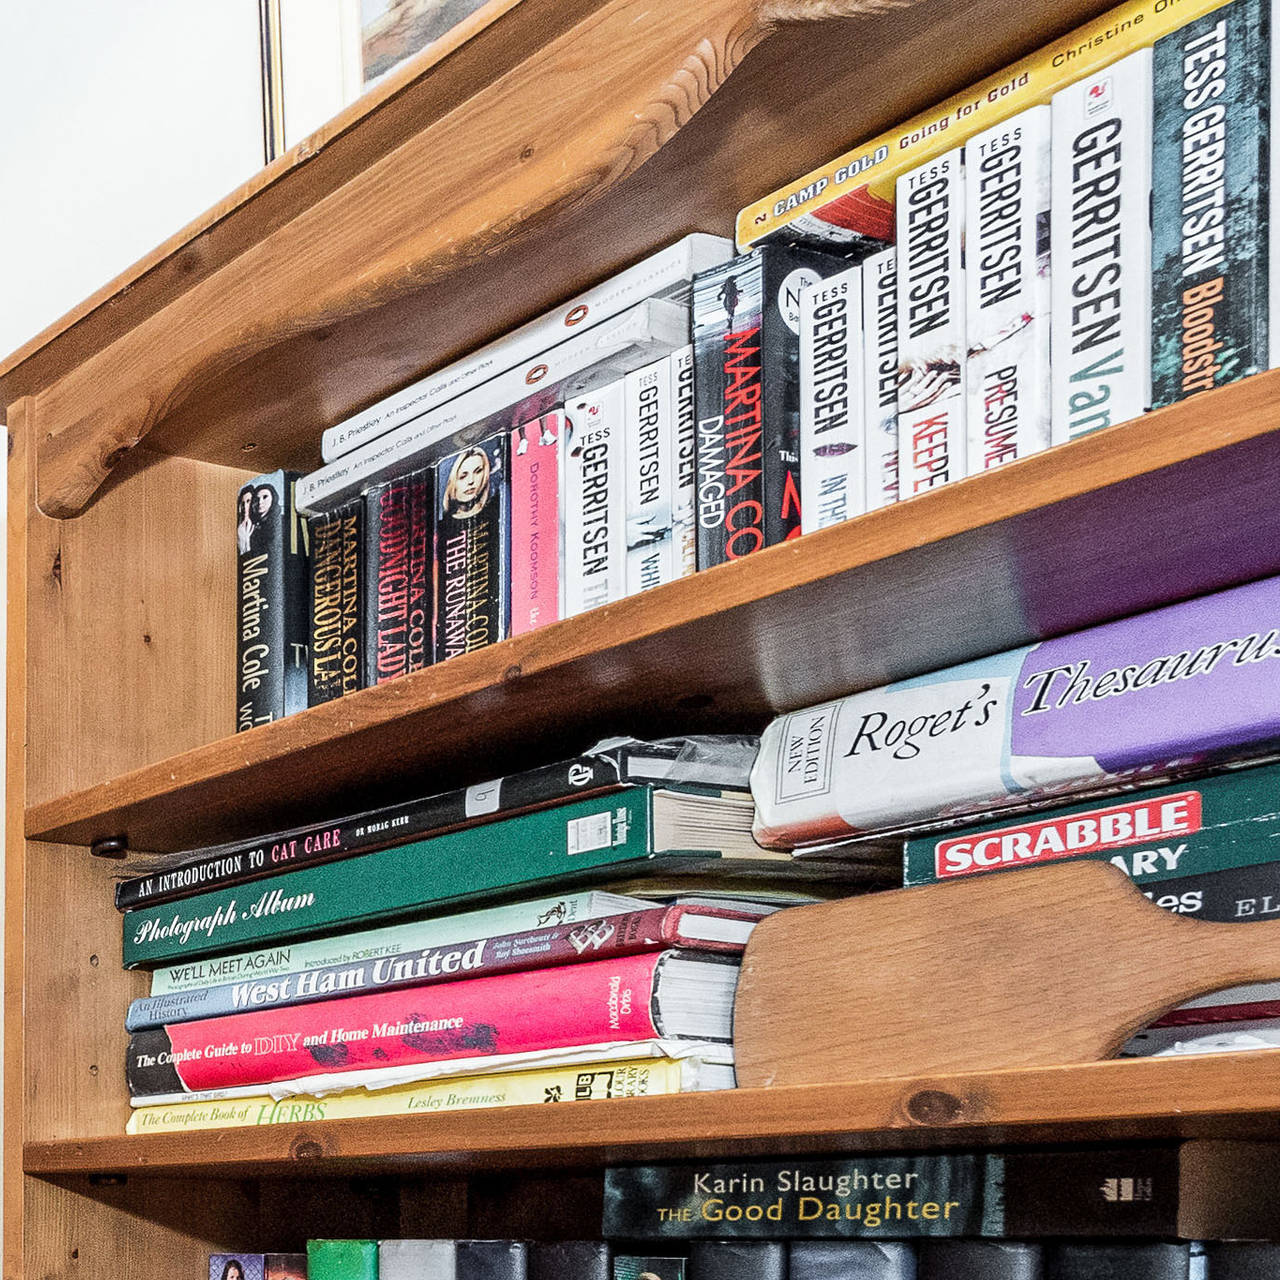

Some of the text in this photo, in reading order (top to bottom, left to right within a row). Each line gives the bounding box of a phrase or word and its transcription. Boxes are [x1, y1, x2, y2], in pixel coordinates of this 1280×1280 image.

[1184, 20, 1227, 110] TESS
[772, 179, 828, 218] CAMP
[834, 145, 889, 185] GOLD
[899, 117, 950, 150] Going
[956, 101, 982, 120] for
[987, 72, 1030, 104] Gold
[1051, 13, 1145, 69] Christine
[978, 127, 1022, 157] TESS
[908, 160, 950, 190] TESS
[1183, 104, 1226, 278] GERRITSEN
[1071, 117, 1123, 355] GERRITSEN
[812, 283, 848, 304] TESS
[580, 427, 611, 445] TESS
[723, 326, 761, 496] MARTINA
[638, 386, 661, 506] GERRITSEN
[698, 414, 725, 529] DAMAGED
[530, 463, 539, 529] DOROTHY
[530, 532, 539, 600] KOOMSON
[241, 553, 270, 692] Martina Cole
[843, 630, 1280, 760] Roget's Thesauru
[786, 734, 804, 774] NEW
[803, 715, 827, 787] EDITION
[945, 800, 1188, 872] SCRABBLE
[133, 888, 316, 946] Photograph Album
[169, 968, 205, 984] WE'LL
[208, 958, 243, 977] MEET
[244, 949, 290, 971] AGAIN
[304, 958, 341, 969] Introduced
[340, 954, 350, 964] by
[352, 947, 383, 959] ROBERT
[383, 944, 402, 955] KEE
[230, 978, 291, 1009] West
[296, 966, 366, 996] Ham
[371, 938, 487, 987] United
[148, 1006, 190, 1021] History
[608, 975, 621, 1030] Macdonald
[619, 988, 633, 1014] Orbis
[136, 1054, 156, 1069] The
[204, 1044, 239, 1059] Guide
[240, 1041, 253, 1054] to
[253, 1032, 302, 1056] DIY
[303, 1033, 327, 1047] and
[330, 1026, 369, 1043] Home
[372, 1016, 464, 1038] Maintenance
[141, 1092, 506, 1126] The Complete Book of HERBS Lesley Bremness
[655, 1196, 960, 1228] THE Good Daughter
[693, 1169, 919, 1197] Karin Slaughter
